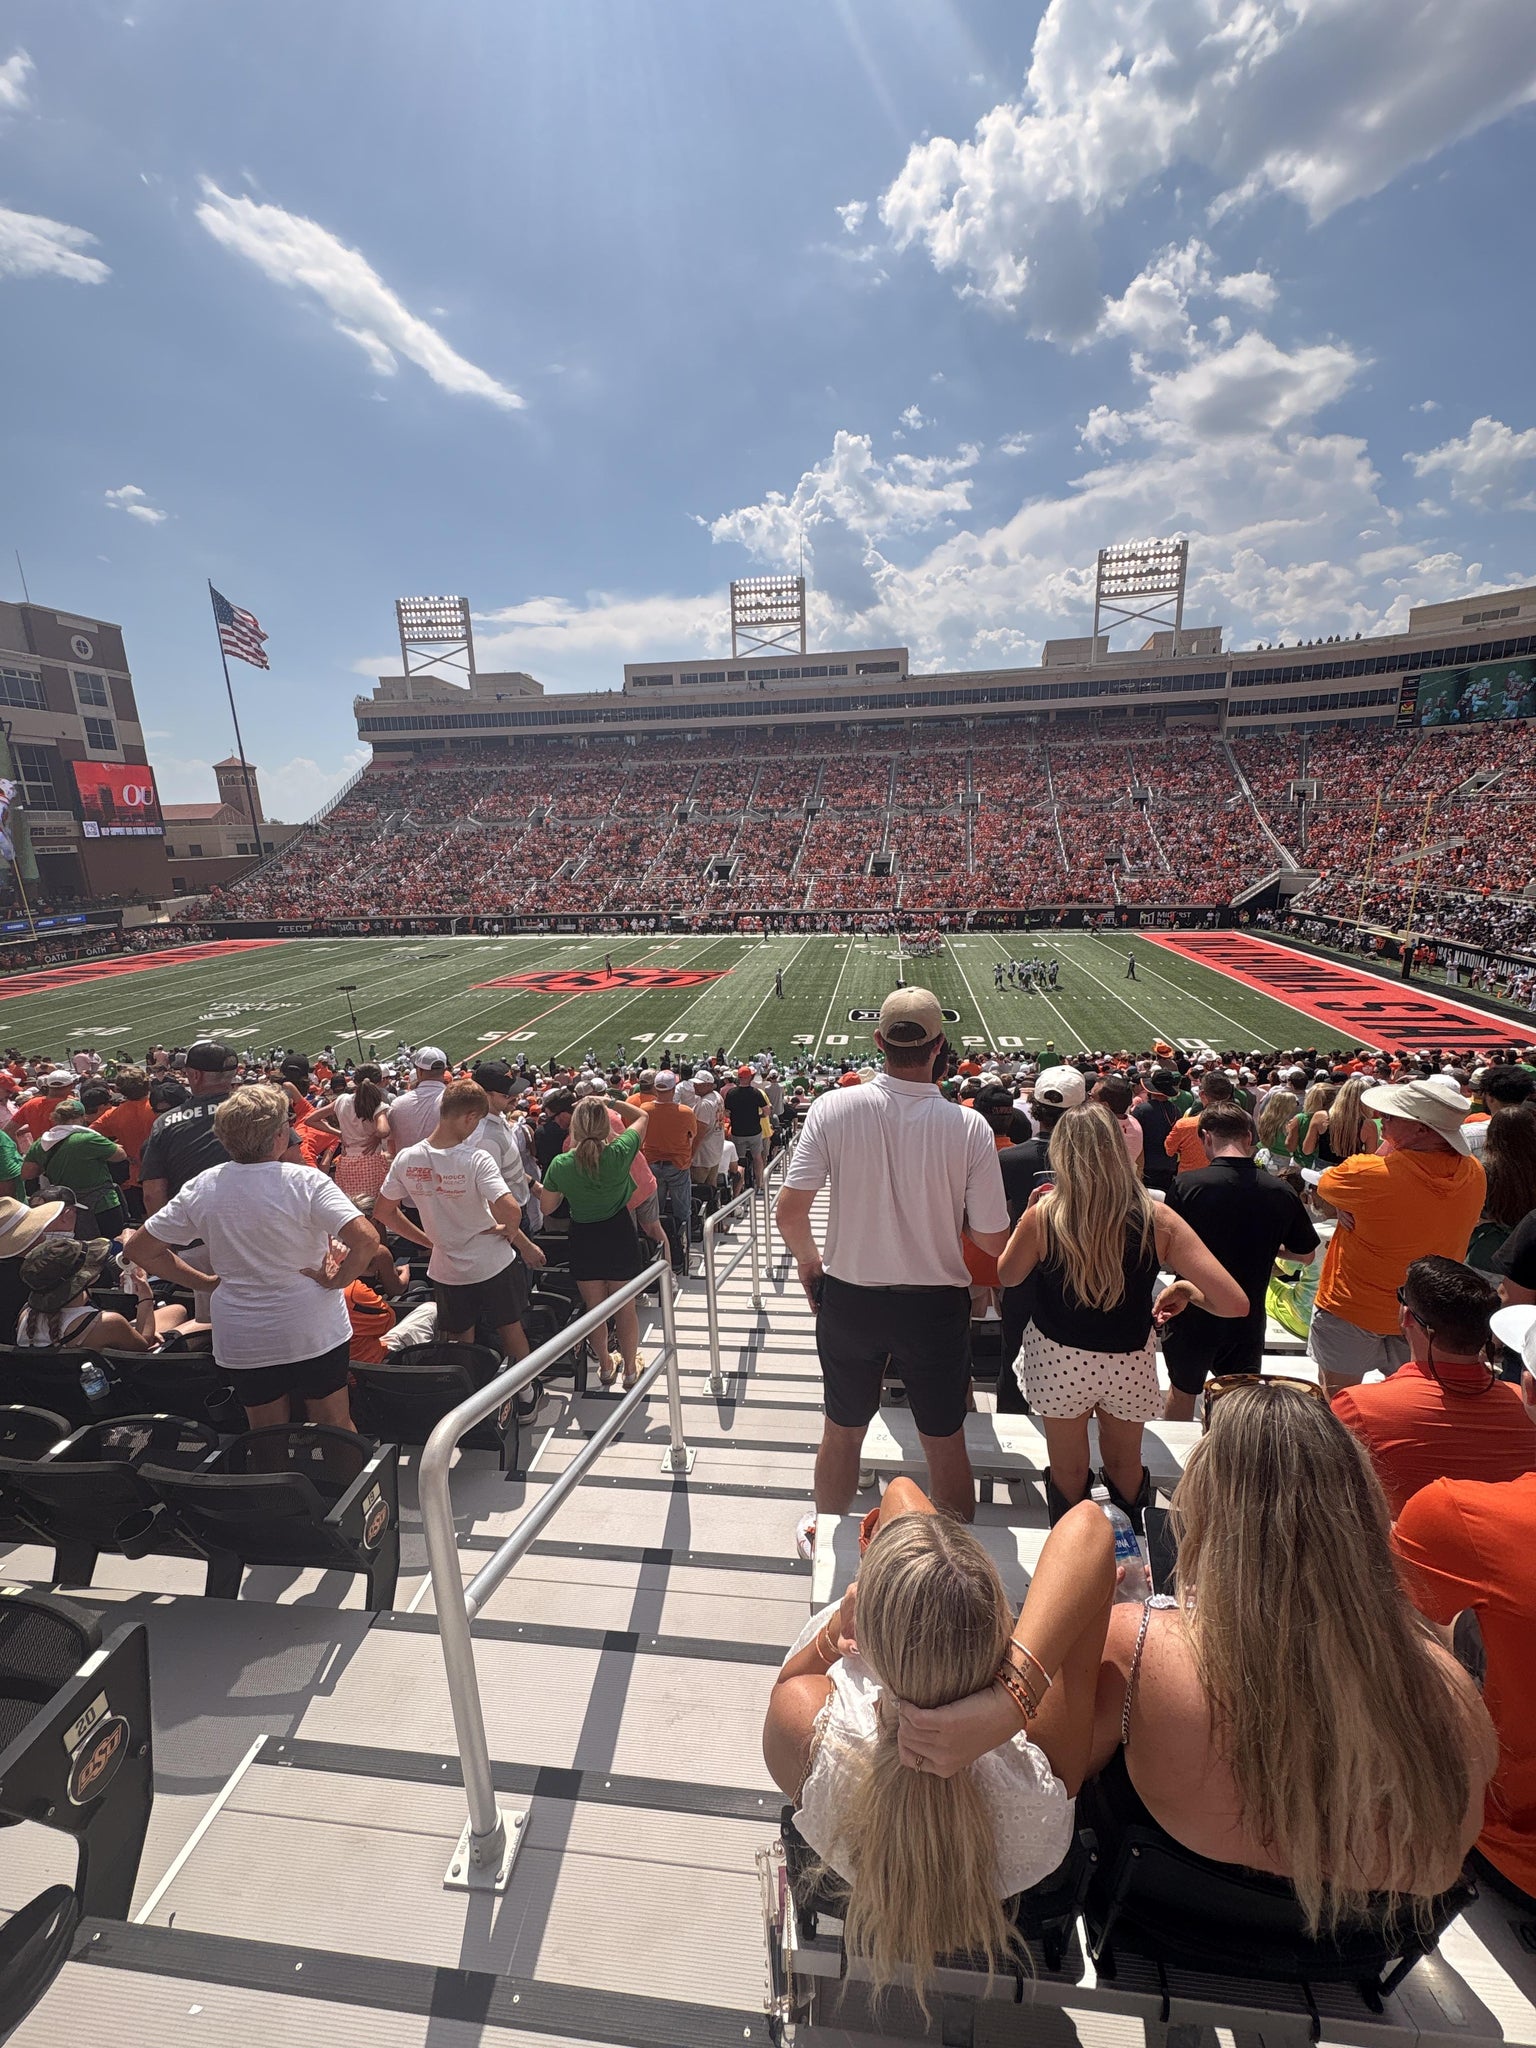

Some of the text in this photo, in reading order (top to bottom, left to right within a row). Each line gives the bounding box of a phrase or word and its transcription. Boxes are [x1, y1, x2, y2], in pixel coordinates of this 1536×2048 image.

[277, 925, 310, 933] ZEECO
[86, 946, 107, 956] OATH
[44, 953, 67, 963] OATH
[1454, 950, 1489, 972] NATIONAL
[1164, 937, 1536, 1049] OKLAHOMA STAT
[66, 1027, 133, 1036] 20
[196, 1028, 260, 1038] 30
[334, 1029, 395, 1039] 40
[477, 1031, 538, 1041] 50
[630, 1032, 689, 1043] 40
[790, 1034, 850, 1046] 30
[961, 1036, 1025, 1047] 20
[164, 1106, 203, 1127] SHOE
[74, 1707, 96, 1737] 20
